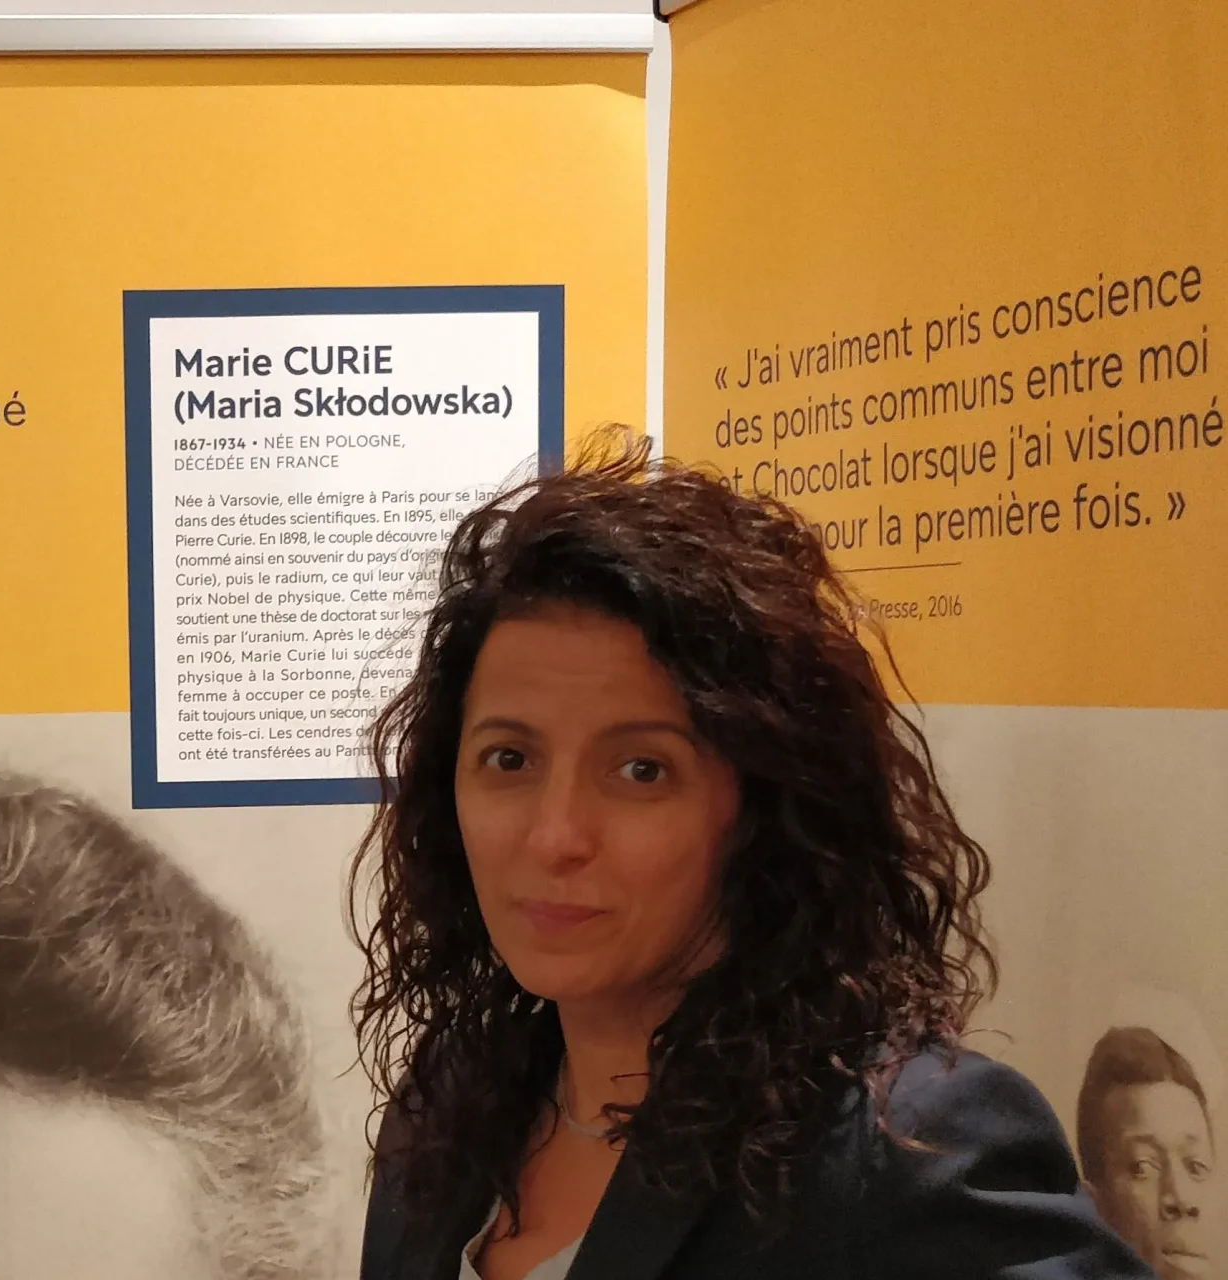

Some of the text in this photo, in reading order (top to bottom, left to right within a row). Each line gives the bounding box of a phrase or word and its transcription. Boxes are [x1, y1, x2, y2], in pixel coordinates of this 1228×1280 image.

[738, 343, 779, 389] J'ai
[790, 317, 912, 379] vraiment
[926, 304, 980, 364] pris
[993, 265, 1201, 339] conscience
[175, 345, 392, 378] Marie CURiE
[716, 325, 1208, 450] des points communs entre moi
[175, 384, 512, 425] (Maria Skłodowska)
[175, 437, 246, 452] 1867-1934
[265, 433, 293, 449] NÉE
[300, 435, 319, 449] EN
[327, 434, 406, 449] POLOGNE,
[753, 447, 872, 499] Chocolat
[884, 440, 996, 487] lorsque
[1007, 420, 1051, 481] j'ai
[1065, 395, 1224, 462] visionné
[175, 454, 338, 472] DÉCÉDÉE EN FRANCE
[175, 495, 202, 508] Née
[208, 494, 215, 507] à
[220, 493, 282, 507] Varsovie,
[288, 492, 312, 506] elle
[317, 491, 364, 507] émigre
[370, 491, 376, 504] à
[382, 490, 414, 503] Paris
[420, 493, 451, 505] pour
[455, 491, 470, 501] se
[175, 508, 463, 528] dans des études scientifiques. En 1895, elle
[879, 505, 901, 547] la
[916, 490, 1060, 554] première
[1073, 481, 1150, 531] fois.
[176, 529, 452, 547] Pierre Curie. En 1898, le couple découvre le
[176, 553, 231, 569] (nommé
[235, 552, 263, 566] ainsi
[268, 554, 284, 564] en
[288, 550, 344, 564] souvenir
[347, 550, 363, 563] du
[368, 552, 397, 565] pays
[176, 569, 437, 589] Curie), puis le radium, ce qui leur vaut
[177, 589, 436, 608] prix Nobel de physique. Cette même
[927, 595, 963, 617] 2016
[177, 608, 421, 626] soutient une thèse de doctorat sur les
[177, 632, 209, 645] émis
[214, 634, 236, 646] par
[241, 630, 308, 644] l’uranium.
[313, 629, 353, 644] Après
[358, 628, 370, 640] le
[177, 654, 194, 664] en
[201, 650, 235, 665] 1906,
[242, 649, 281, 663] Marie
[287, 648, 325, 662] Curie
[332, 648, 347, 661] lui
[178, 670, 242, 686] physique
[249, 670, 256, 682] à
[263, 669, 274, 681] la
[281, 667, 355, 681] Sorbonne,
[178, 685, 397, 703] femme à occuper ce poste. En
[178, 708, 199, 722] fait
[203, 709, 255, 724] toujours
[259, 707, 306, 722] unique,
[311, 709, 326, 720] un
[178, 728, 213, 742] cette
[217, 727, 264, 741] fois-ci.
[269, 728, 292, 740] Les
[297, 725, 352, 739] cendres
[179, 749, 201, 760] ont
[206, 747, 227, 760] été
[233, 745, 310, 759] transférées
[315, 748, 330, 757] au
